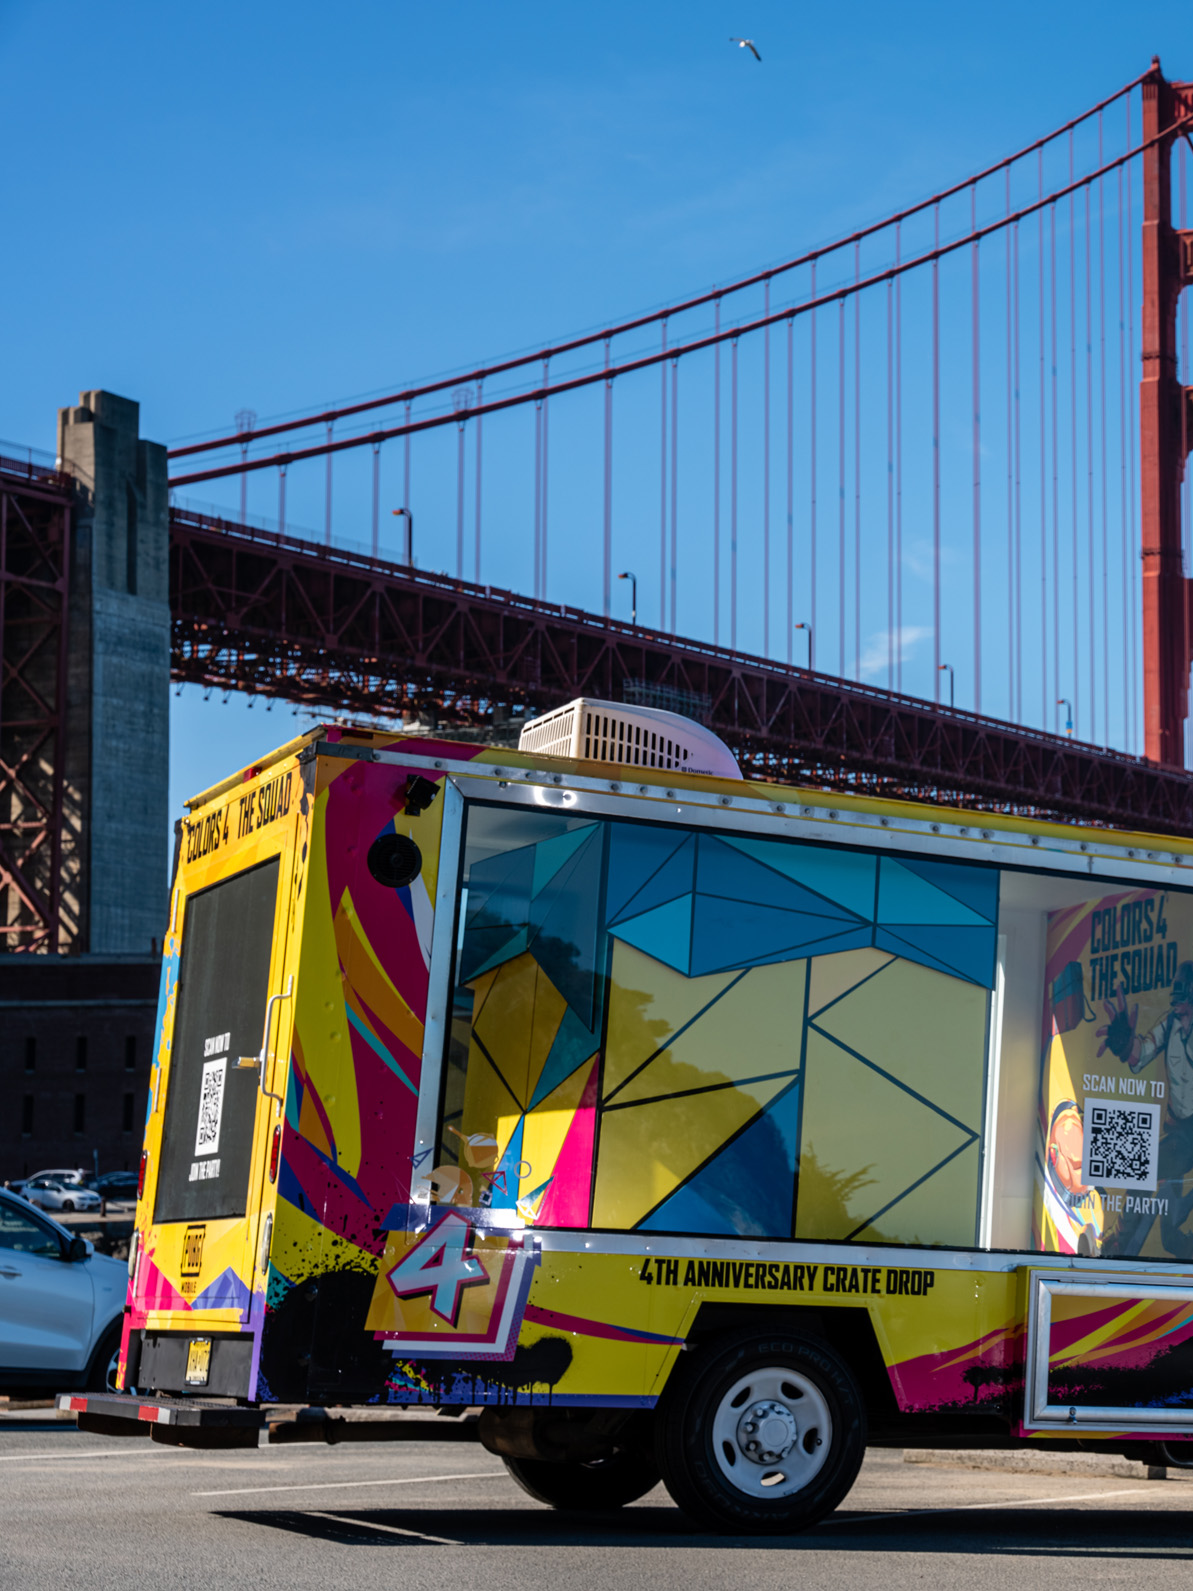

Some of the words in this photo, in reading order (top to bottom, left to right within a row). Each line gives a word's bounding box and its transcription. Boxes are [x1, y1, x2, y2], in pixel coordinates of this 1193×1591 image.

[187, 809, 223, 864] COLORS
[222, 803, 230, 845] 4
[238, 791, 256, 839] THE
[257, 772, 292, 830] SQUAD
[1090, 897, 1154, 954] COLORS
[1155, 894, 1168, 939] 4
[1089, 953, 1119, 1002] THE
[1120, 941, 1178, 996] SQUAD
[1082, 1073, 1116, 1093] SCAN
[1119, 1077, 1147, 1096] NOW
[1150, 1080, 1165, 1098] TO
[1101, 1194, 1123, 1212] THE
[1125, 1196, 1169, 1215] PARTY!
[385, 1209, 490, 1329] 4
[640, 1258, 678, 1287] 4TH
[683, 1260, 819, 1292] ANNIVERSARY
[823, 1266, 881, 1294] CRATE
[886, 1269, 935, 1297] DROP
[757, 1341, 794, 1353] ECO
[797, 1346, 833, 1370] PRO
